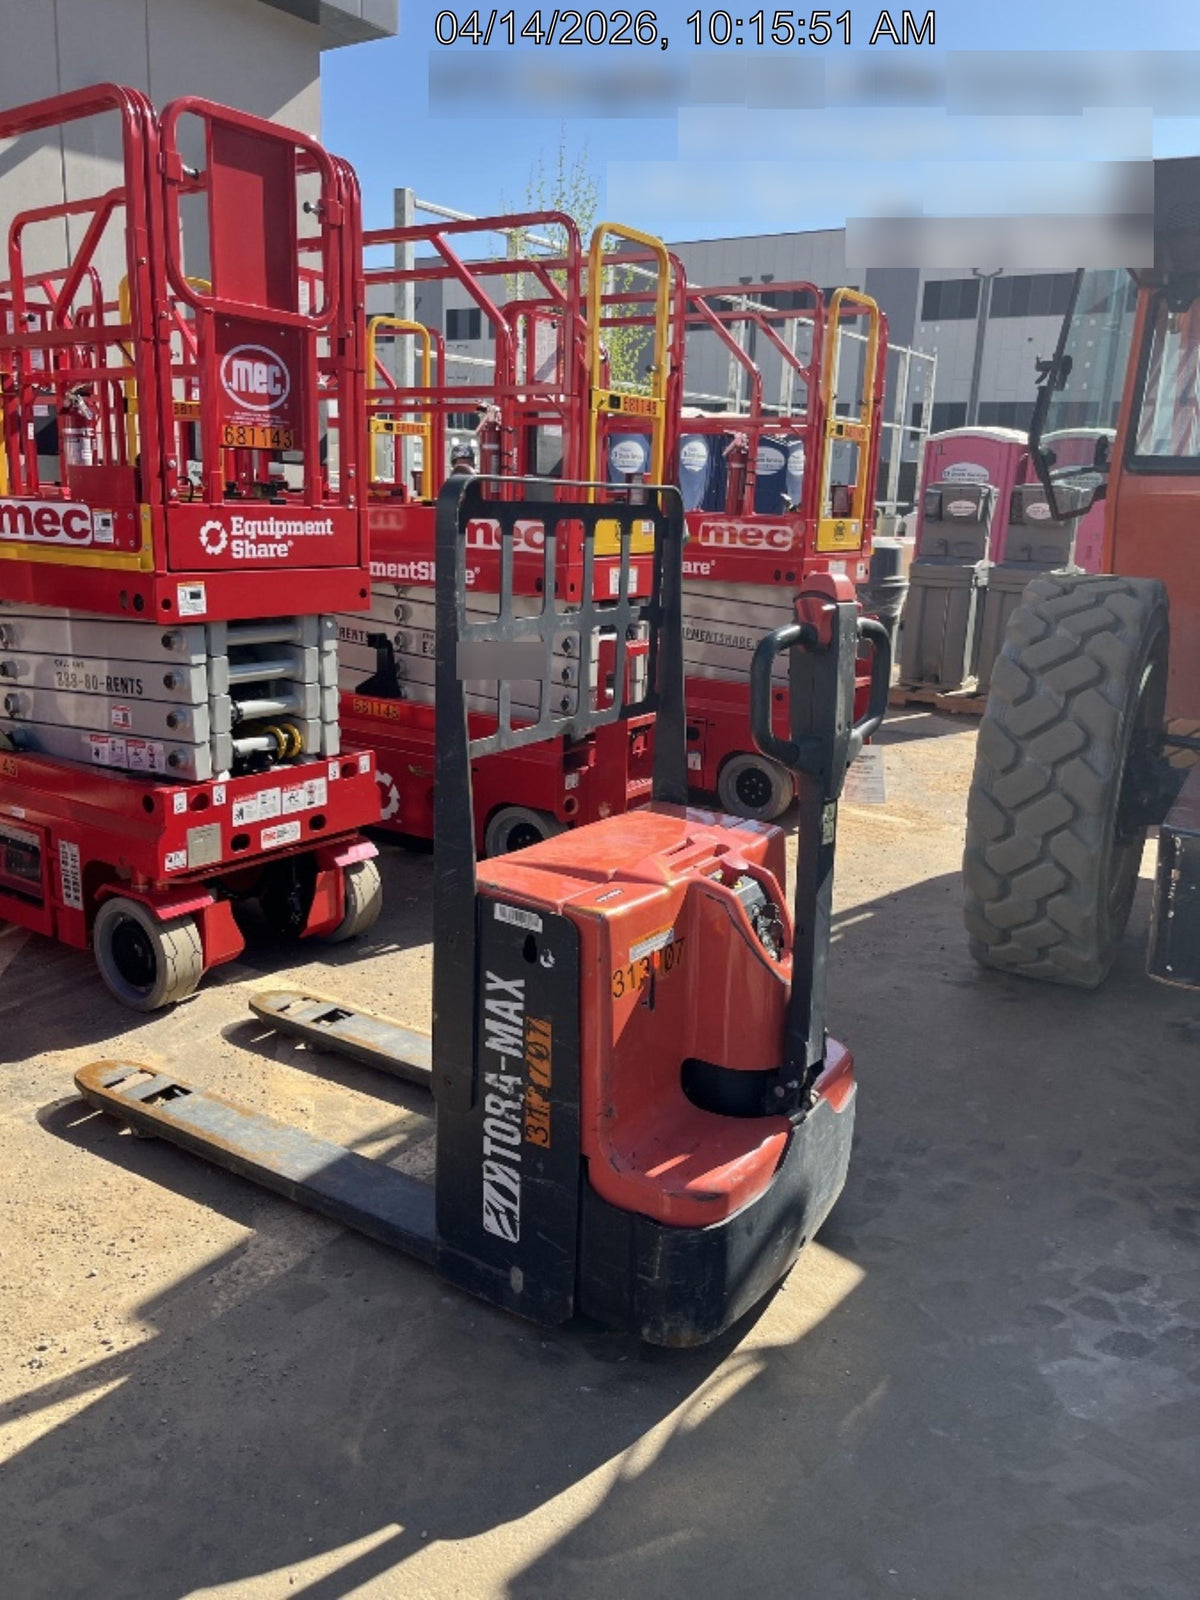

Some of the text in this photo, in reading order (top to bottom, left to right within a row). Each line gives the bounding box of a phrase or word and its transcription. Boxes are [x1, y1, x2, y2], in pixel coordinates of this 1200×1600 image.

[232, 359, 281, 395] mec
[224, 425, 292, 449] 681143
[0, 504, 91, 540] mec
[230, 516, 334, 540] Equipment
[700, 524, 790, 548] mec
[484, 970, 525, 1161] TORA-MAX
